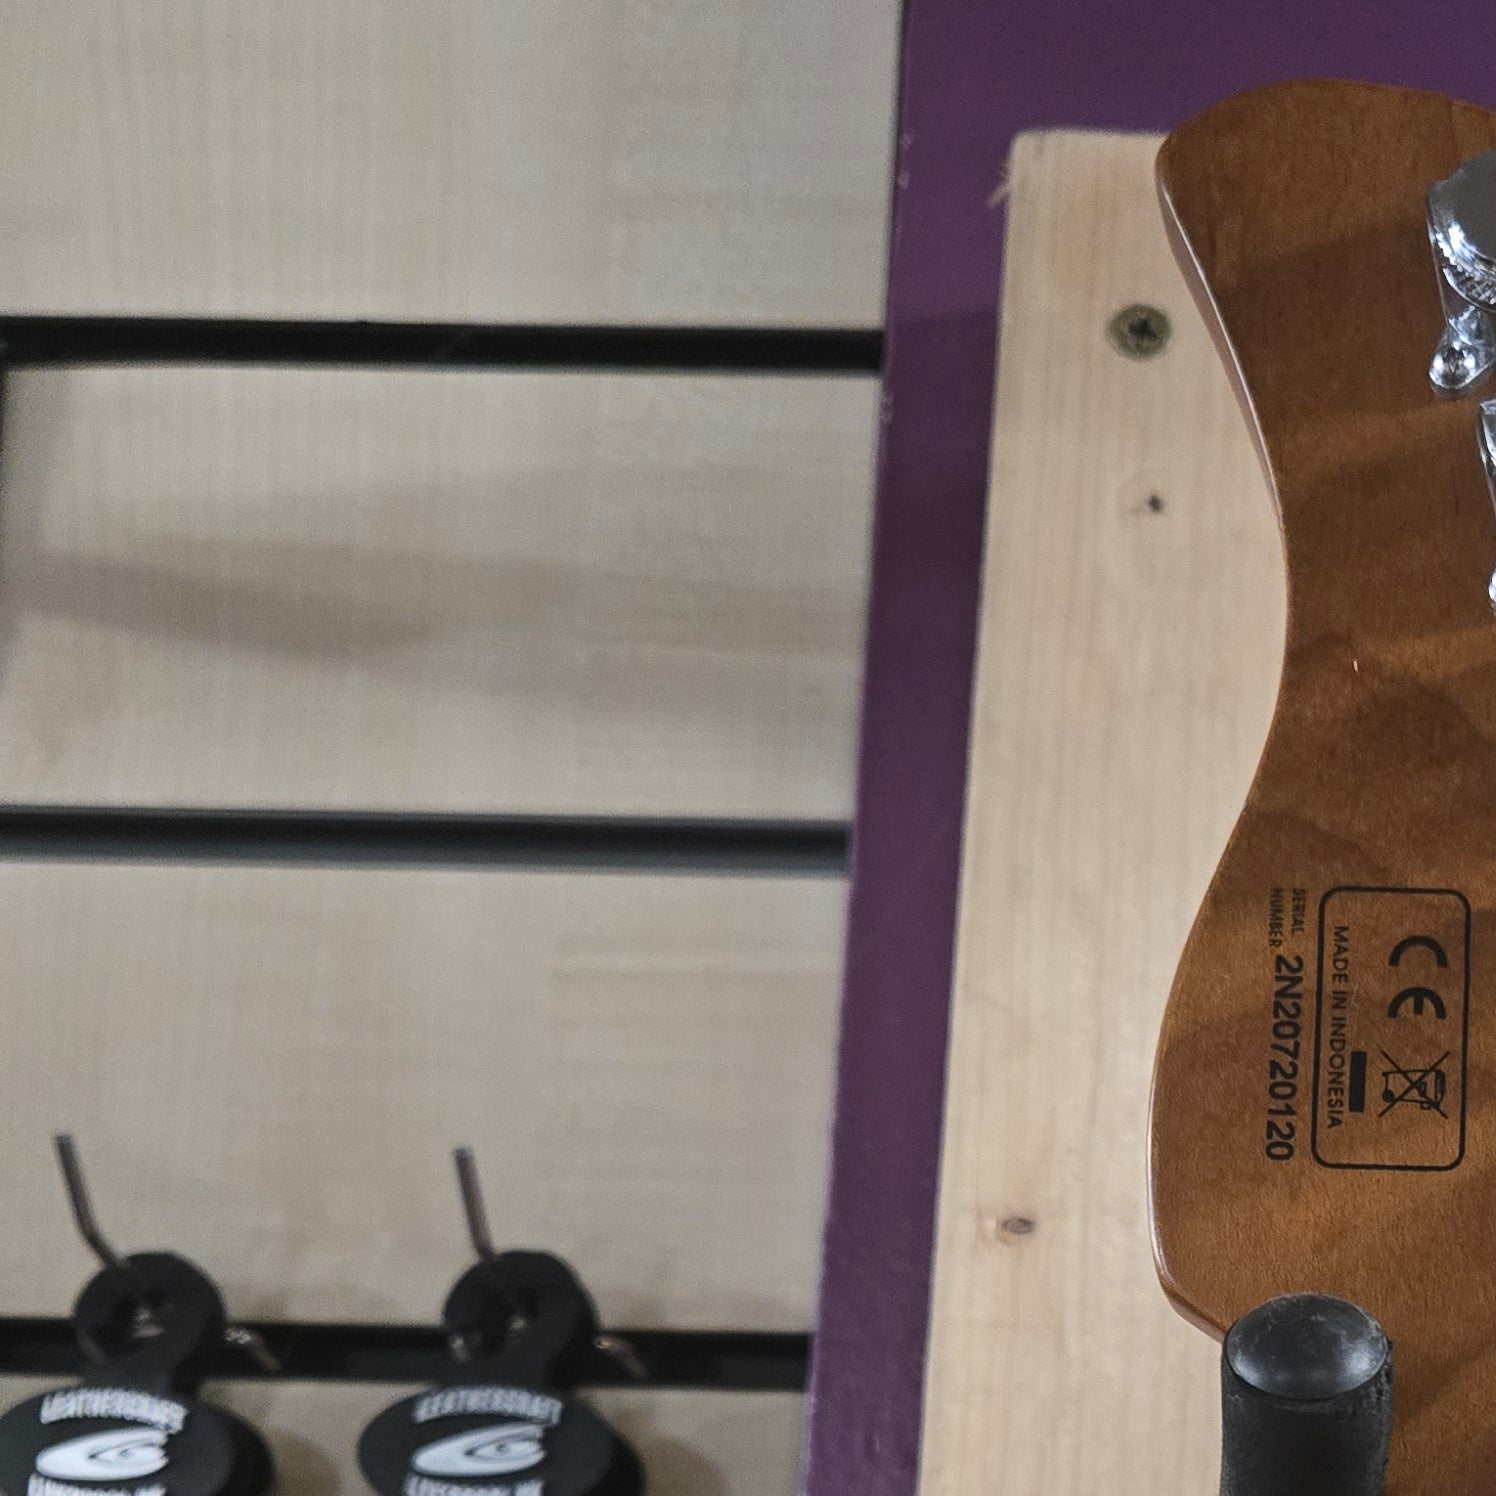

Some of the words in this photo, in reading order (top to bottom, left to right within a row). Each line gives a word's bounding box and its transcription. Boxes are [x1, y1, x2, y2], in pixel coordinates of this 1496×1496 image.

[1269, 887, 1284, 948] NUMBER
[1290, 888, 1305, 935] SERIAL
[1332, 925, 1350, 983] MADE
[1387, 934, 1448, 1019] CE
[1331, 990, 1347, 1011] IN
[1265, 954, 1305, 1161] 2N20720120
[1327, 1014, 1347, 1129] INDONESIA
